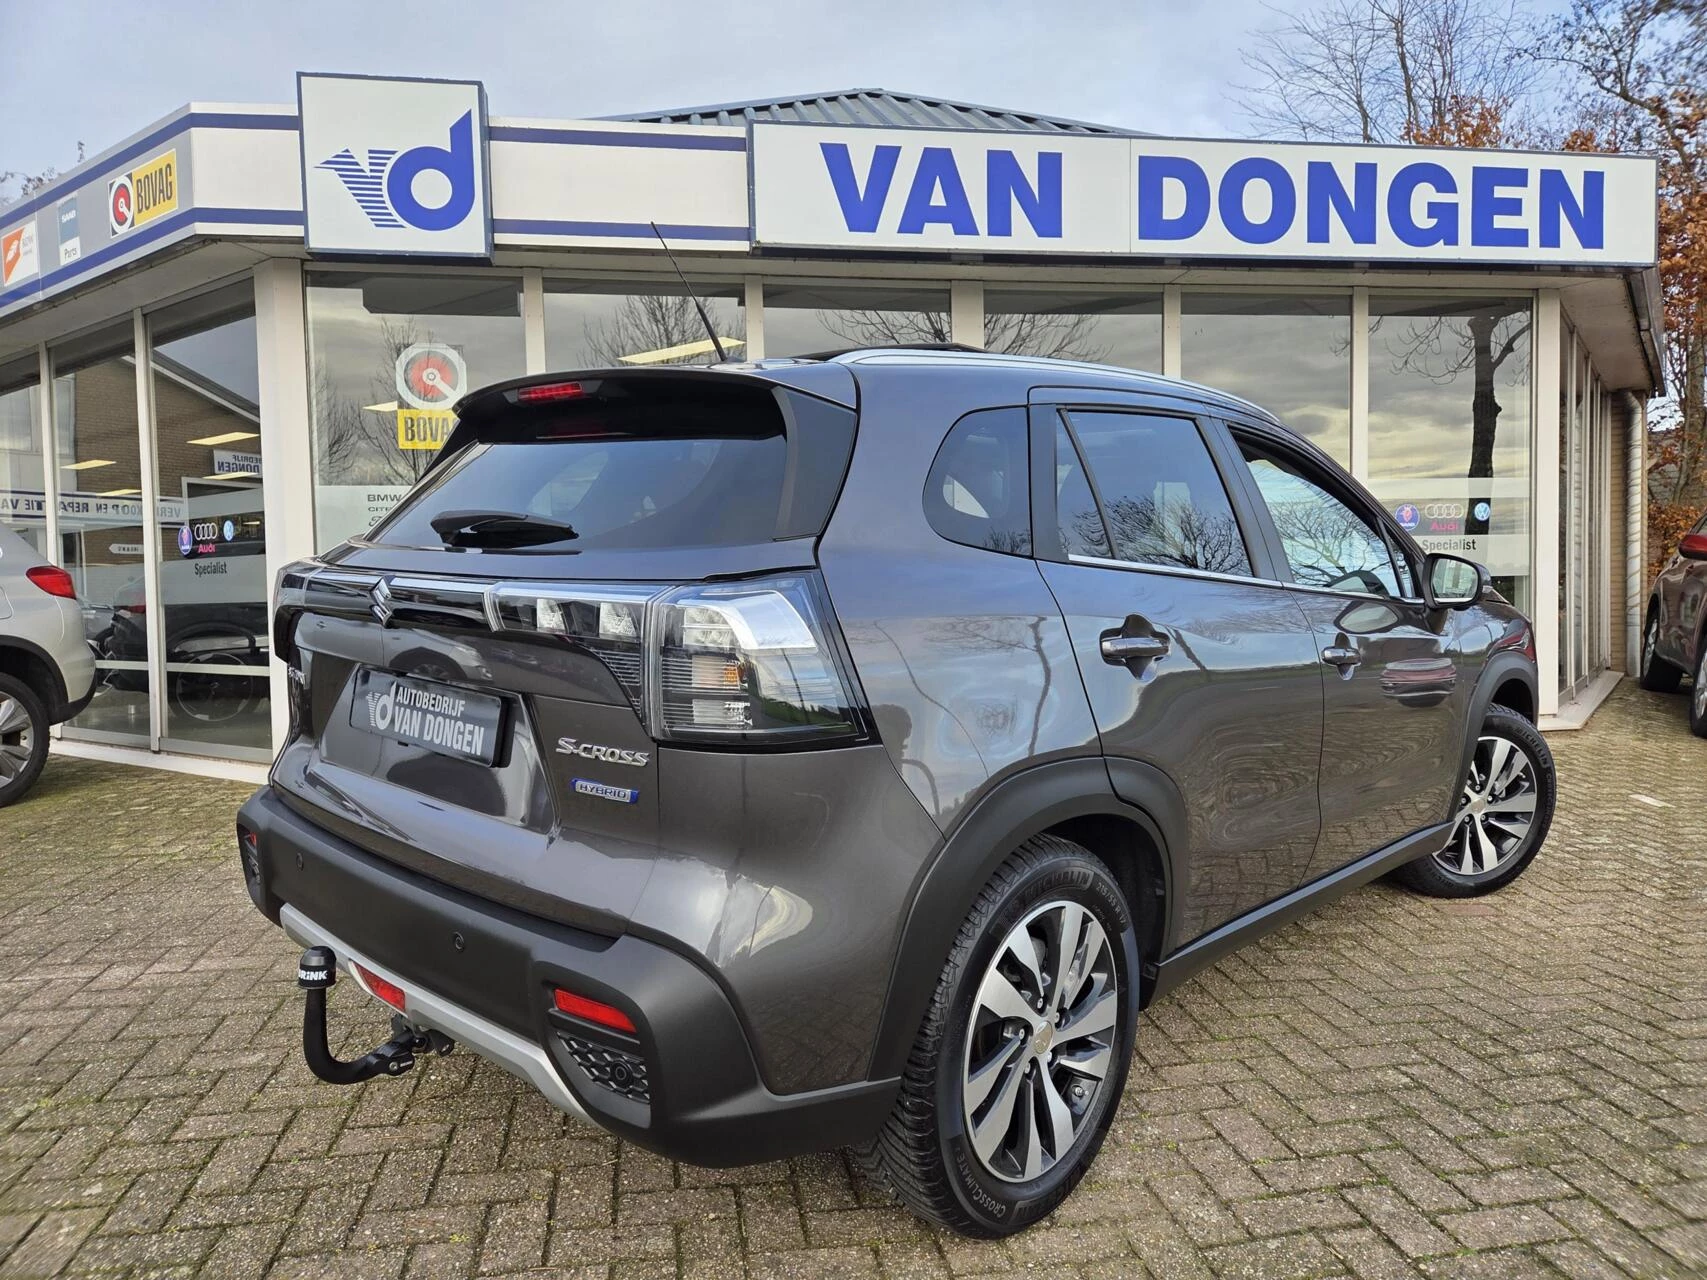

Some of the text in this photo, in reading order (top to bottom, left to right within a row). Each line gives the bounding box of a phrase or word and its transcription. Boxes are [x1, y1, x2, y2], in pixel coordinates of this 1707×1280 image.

[136, 162, 173, 214] BOVAG
[819, 142, 1605, 250] VAN DONGEN
[367, 494, 402, 502] BMW
[1430, 521, 1458, 531] Audi
[198, 543, 216, 553] Audi
[1422, 538, 1477, 553] Specialist
[194, 561, 228, 577] Specialist
[396, 686, 466, 718] AUTOBEDRIJF
[393, 705, 485, 756] VAN DONGEN
[579, 783, 627, 799] HYBRID
[956, 1152, 1007, 1218] CROSSCLIMATE
